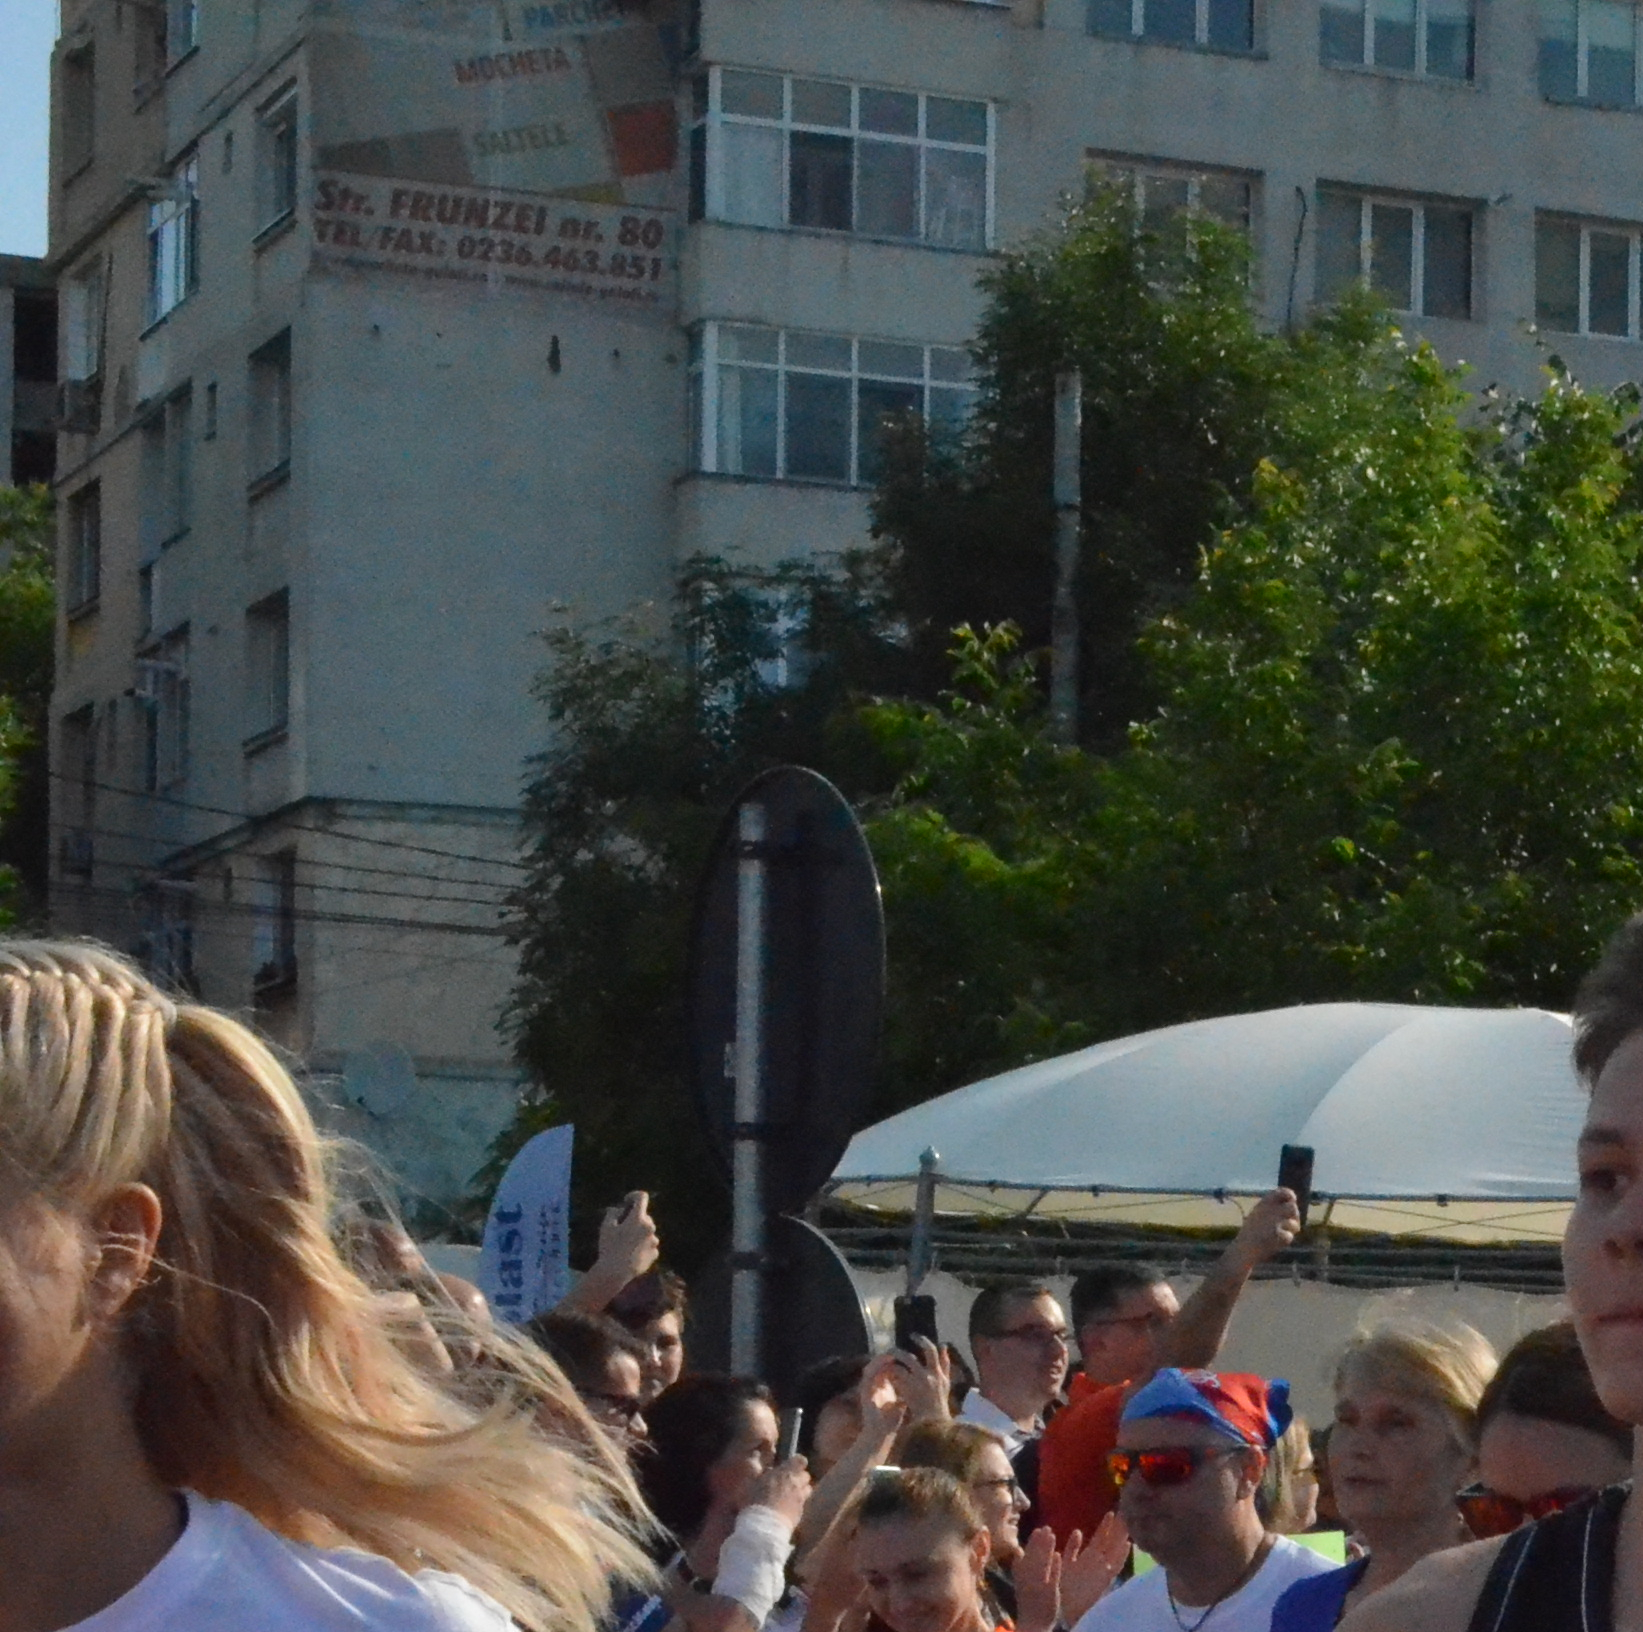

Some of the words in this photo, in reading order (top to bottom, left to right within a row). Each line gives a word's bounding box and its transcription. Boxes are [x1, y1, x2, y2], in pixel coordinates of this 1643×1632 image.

[389, 187, 548, 237] FRUNZEI
[557, 215, 605, 243] nr.
[618, 215, 665, 250] 80
